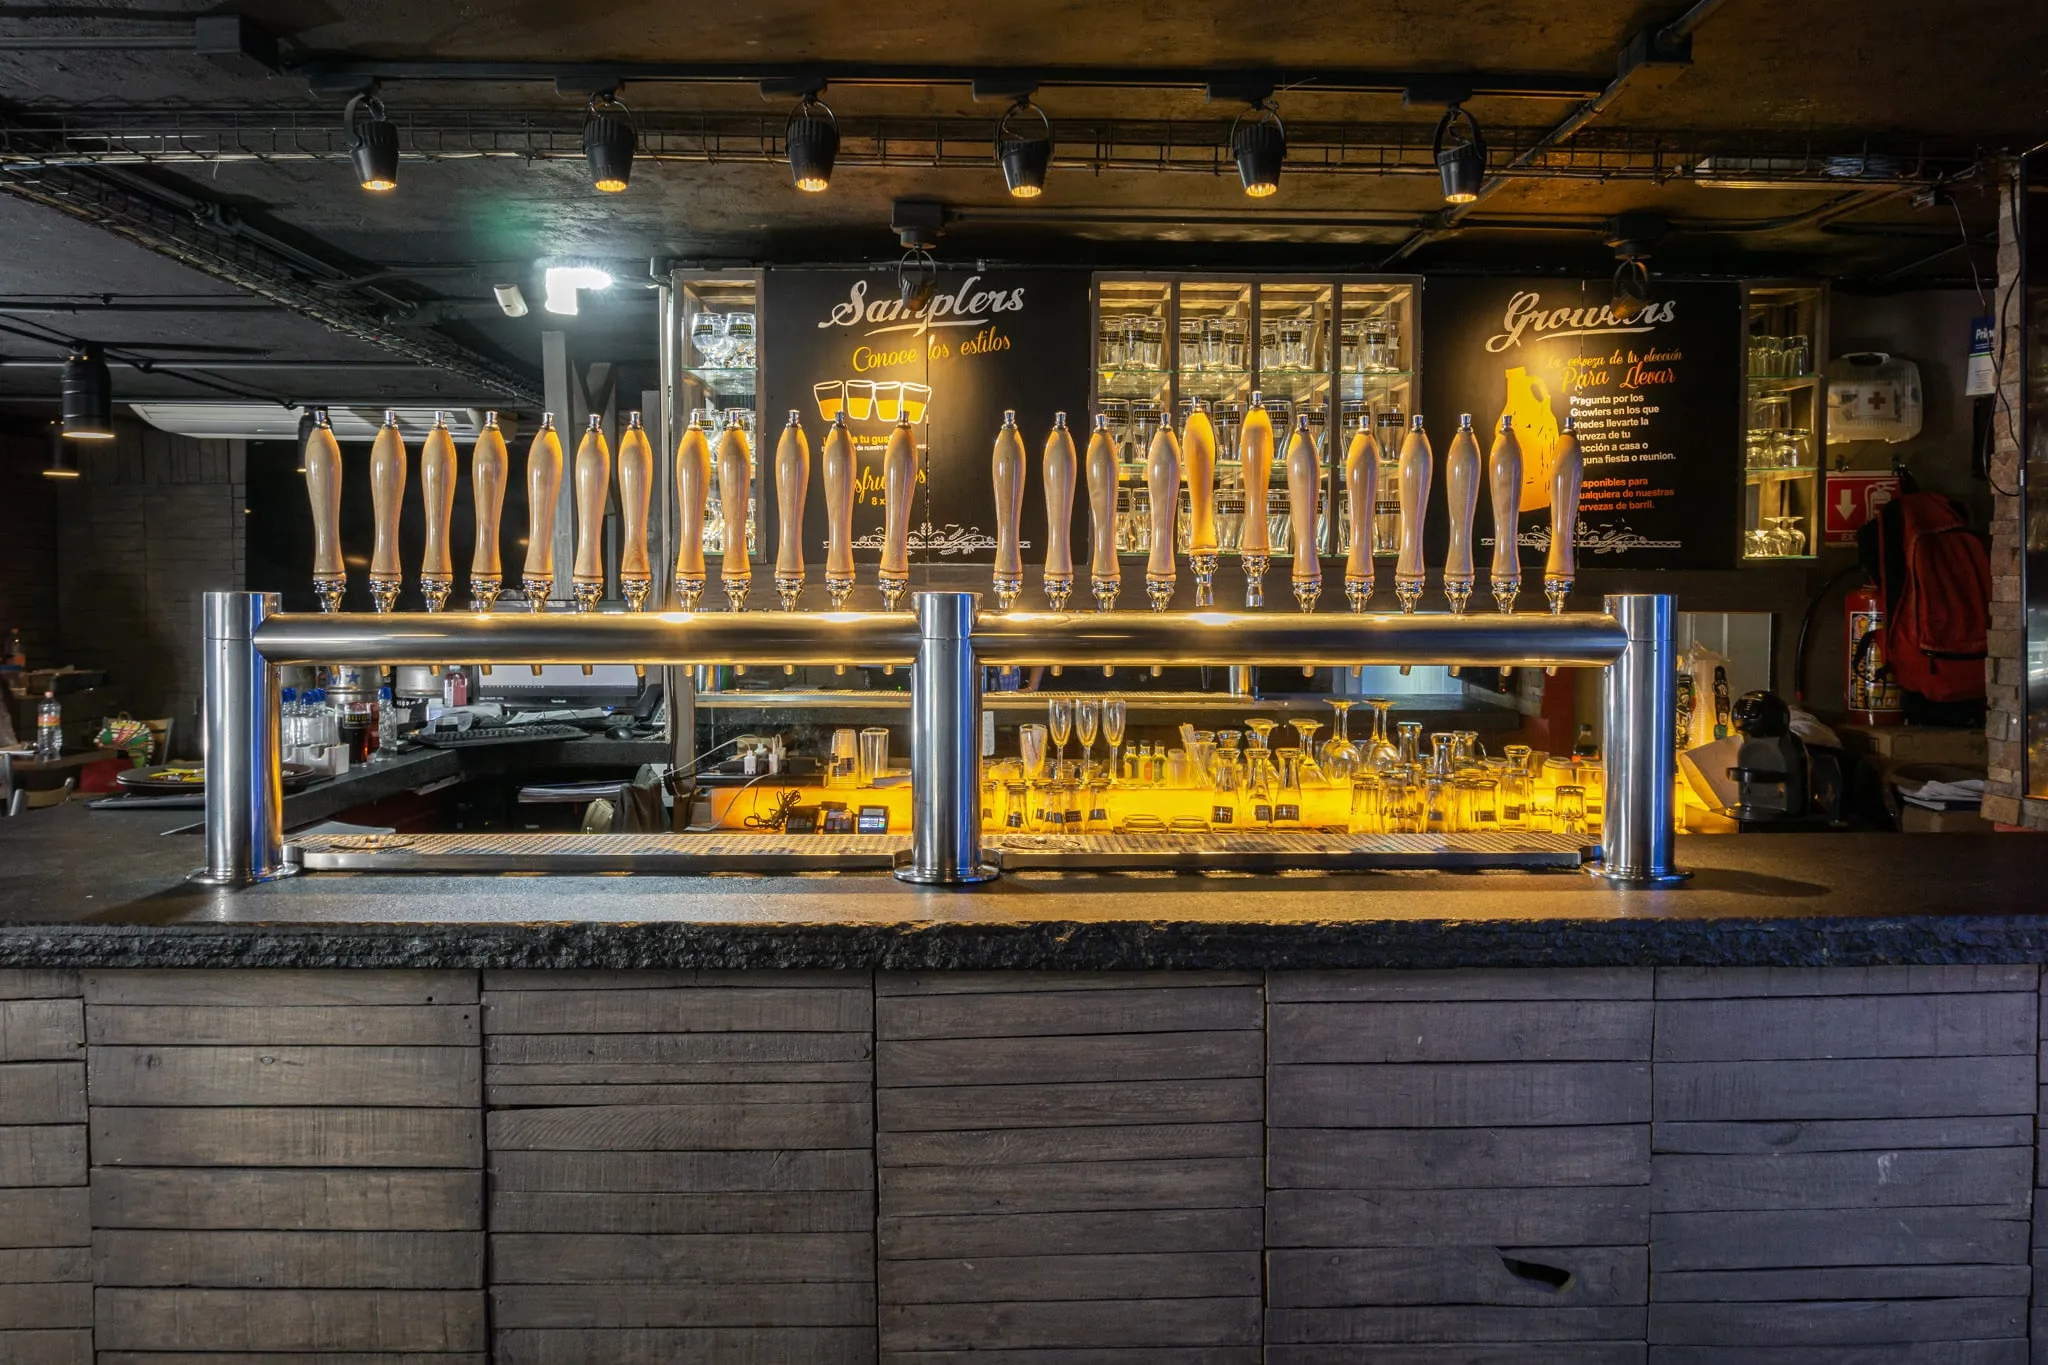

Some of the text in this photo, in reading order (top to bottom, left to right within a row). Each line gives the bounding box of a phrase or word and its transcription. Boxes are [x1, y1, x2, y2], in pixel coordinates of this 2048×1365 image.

[1485, 291, 1677, 352] Growrs
[852, 325, 1011, 372] Conoce los estilos
[1609, 348, 1624, 365] de
[1627, 350, 1640, 364] tu
[1560, 361, 1677, 393] Para Llevar
[1569, 393, 1645, 407] Pregunta por los
[1570, 405, 1660, 417] Growlers en los que
[1606, 416, 1639, 428] llevarte
[1640, 416, 1649, 426] la
[1576, 430, 1631, 441] erveza de tu
[1619, 443, 1640, 451] casa
[1642, 442, 1649, 450] o
[1604, 454, 1630, 463] fiesta
[1631, 454, 1638, 462] o
[1581, 478, 1648, 489] sponibles para
[871, 496, 878, 505] 8
[1578, 488, 1675, 501] ualquiera de nuestras
[1578, 503, 1614, 512] ervezas
[1615, 501, 1628, 510] de
